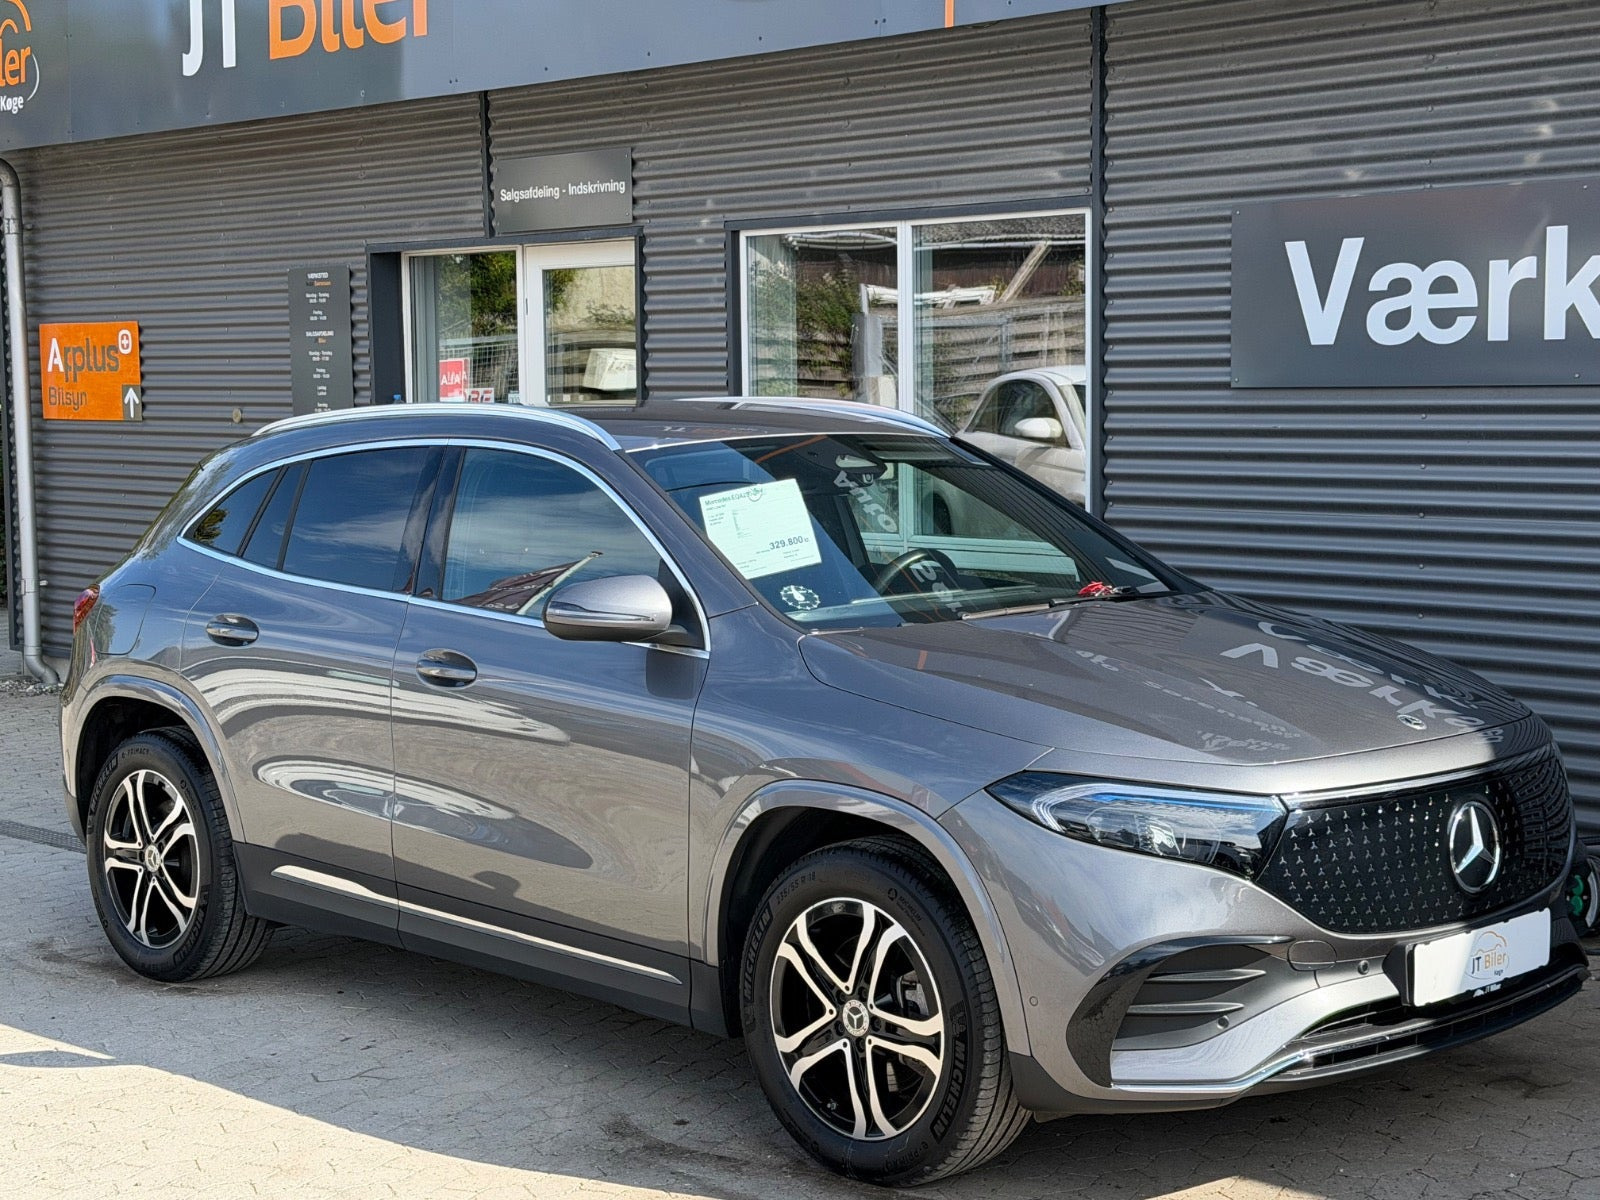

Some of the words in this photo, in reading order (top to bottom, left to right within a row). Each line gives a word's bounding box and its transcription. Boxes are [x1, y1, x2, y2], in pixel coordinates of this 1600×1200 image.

[0, 95, 24, 114] Køge
[500, 186, 560, 203] Salgsafdeling
[568, 179, 626, 195] Indskrivning
[1285, 225, 1600, 345] Værk
[48, 386, 88, 411] Bilsyn
[769, 535, 804, 550] 329.800
[743, 906, 771, 1001] MICHELIN
[1471, 956, 1482, 974] JT
[1484, 951, 1507, 969] Biler
[933, 1039, 966, 1138] MICHELIN
